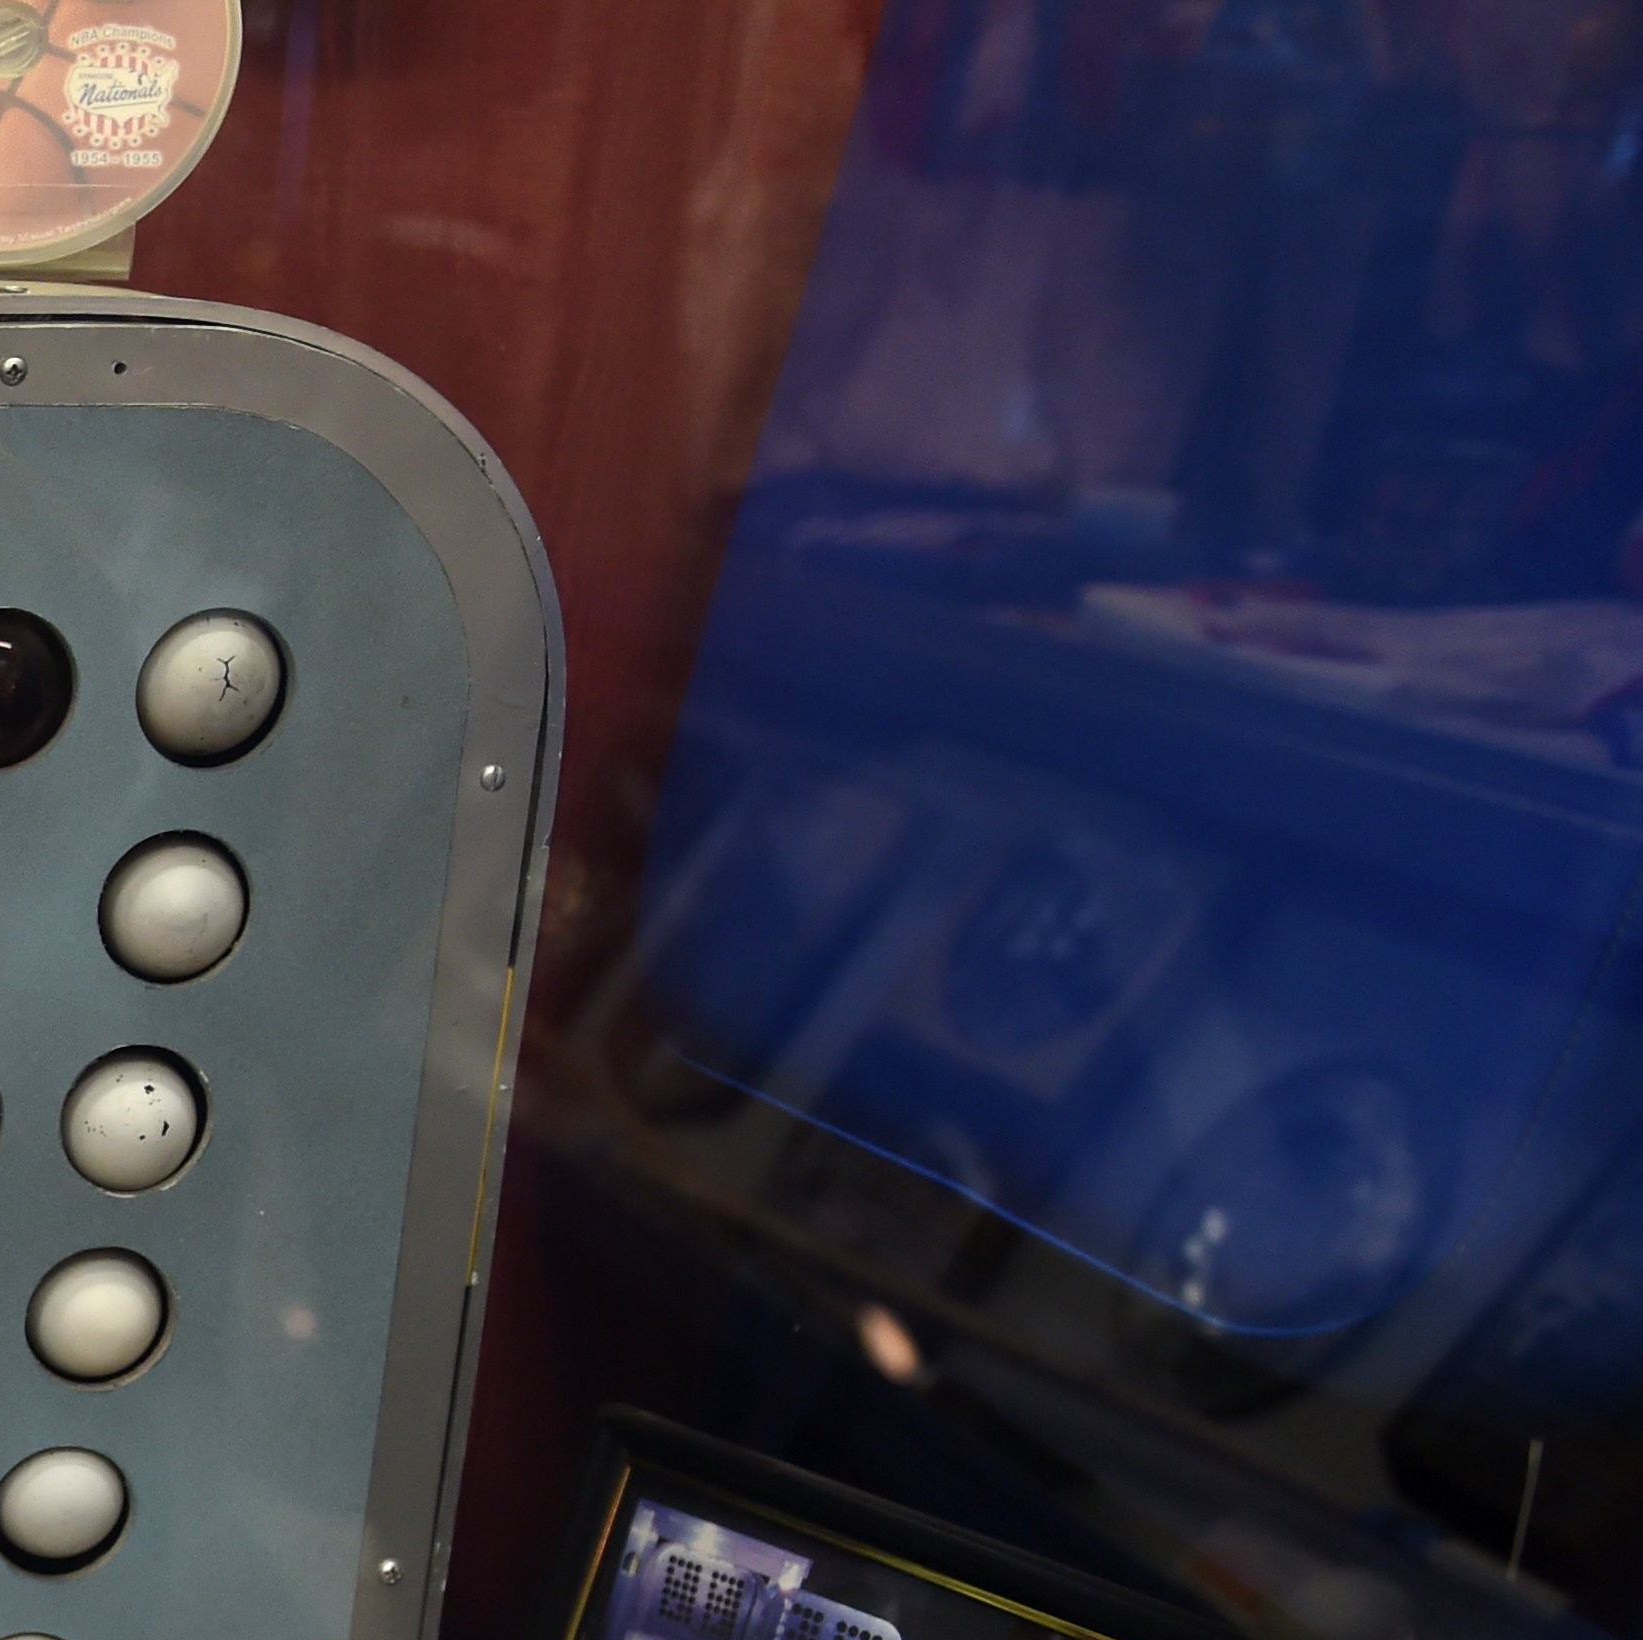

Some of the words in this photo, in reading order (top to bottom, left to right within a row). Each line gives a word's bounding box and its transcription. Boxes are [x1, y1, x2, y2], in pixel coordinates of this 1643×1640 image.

[71, 29, 100, 45] NBA
[102, 26, 174, 48] Champions
[79, 78, 162, 106] Nationals
[73, 153, 108, 165] 1954
[125, 153, 161, 165] 1955
